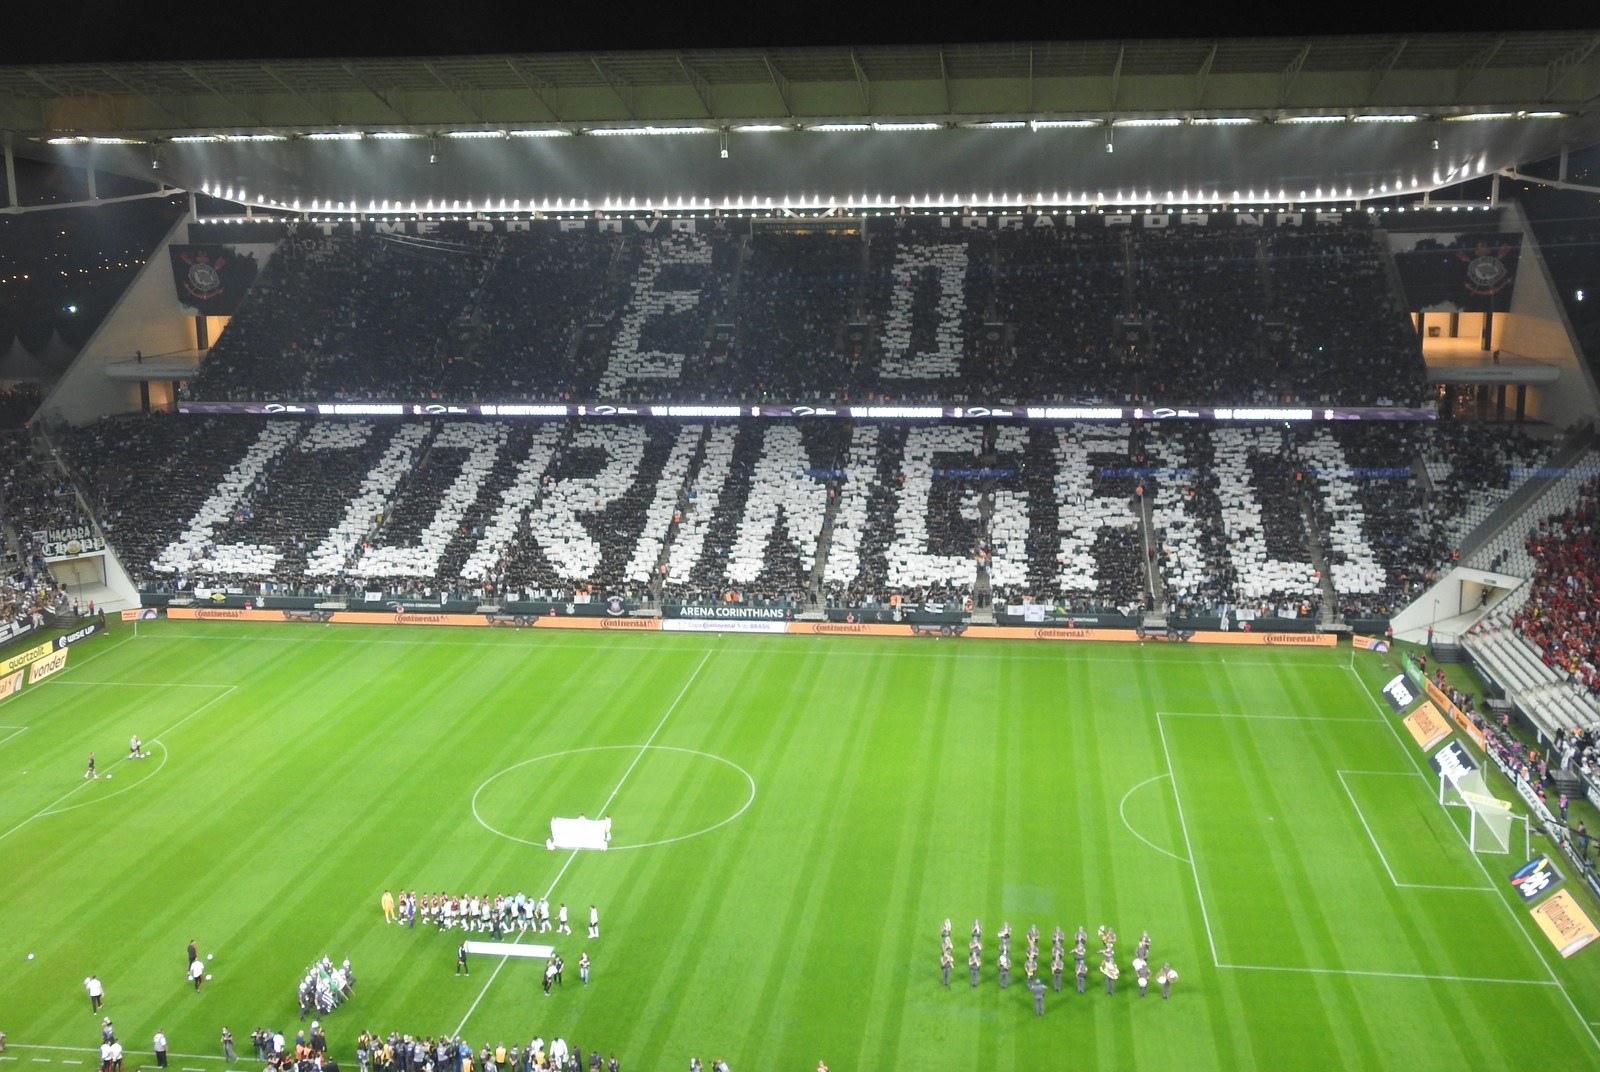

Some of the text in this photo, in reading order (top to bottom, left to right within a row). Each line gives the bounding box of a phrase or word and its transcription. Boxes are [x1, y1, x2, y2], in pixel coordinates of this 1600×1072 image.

[316, 222, 439, 236] TIME
[680, 607, 784, 618] ARENA CORINTHIANS
[601, 618, 647, 629] Continental
[813, 623, 860, 634] Continental
[67, 625, 95, 642] WISE UP
[1264, 633, 1315, 644] Continental
[9, 647, 44, 671] quartzolit
[34, 655, 65, 679] vonder
